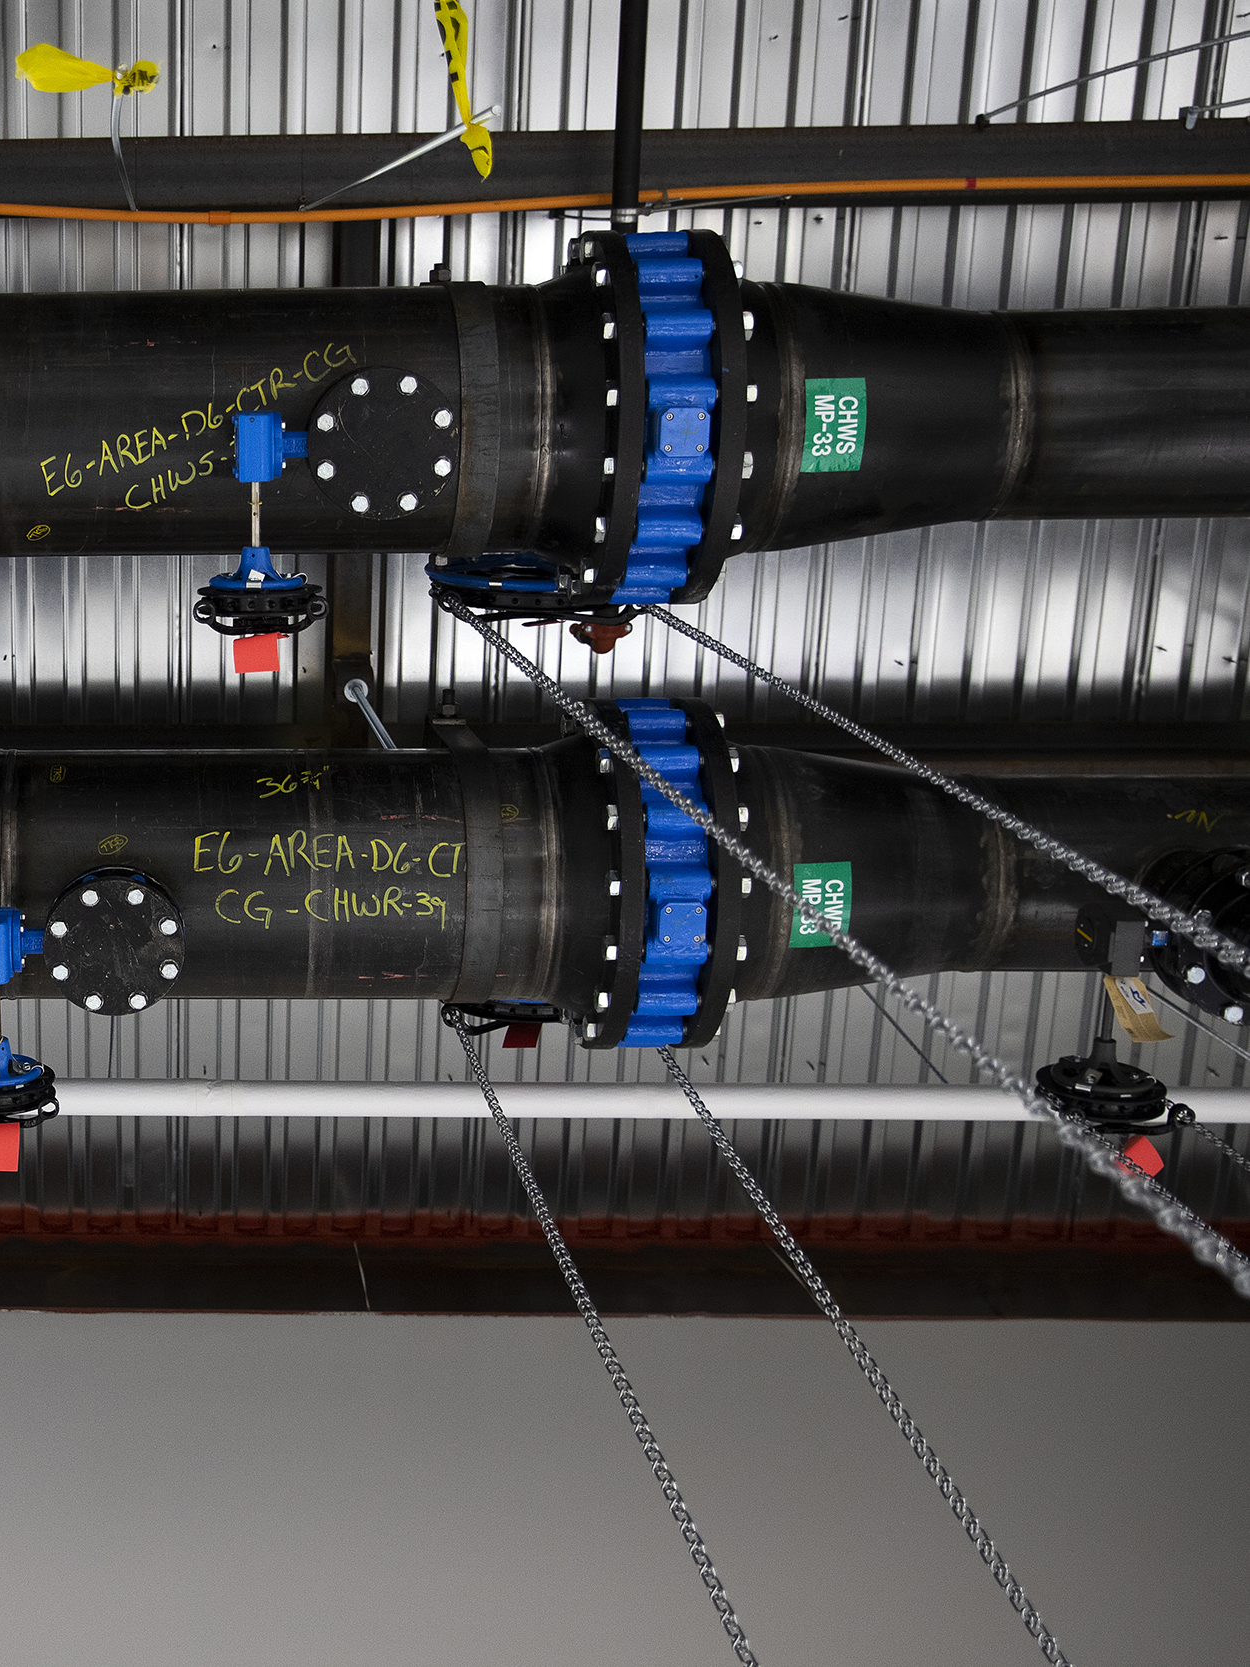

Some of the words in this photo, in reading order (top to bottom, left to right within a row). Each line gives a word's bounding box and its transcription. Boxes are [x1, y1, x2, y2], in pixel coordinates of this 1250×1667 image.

[811, 394, 836, 457] MP-33
[835, 395, 859, 455] CHWS
[193, 829, 468, 878] E6-AREA-D6-CT
[798, 878, 822, 935] MP33
